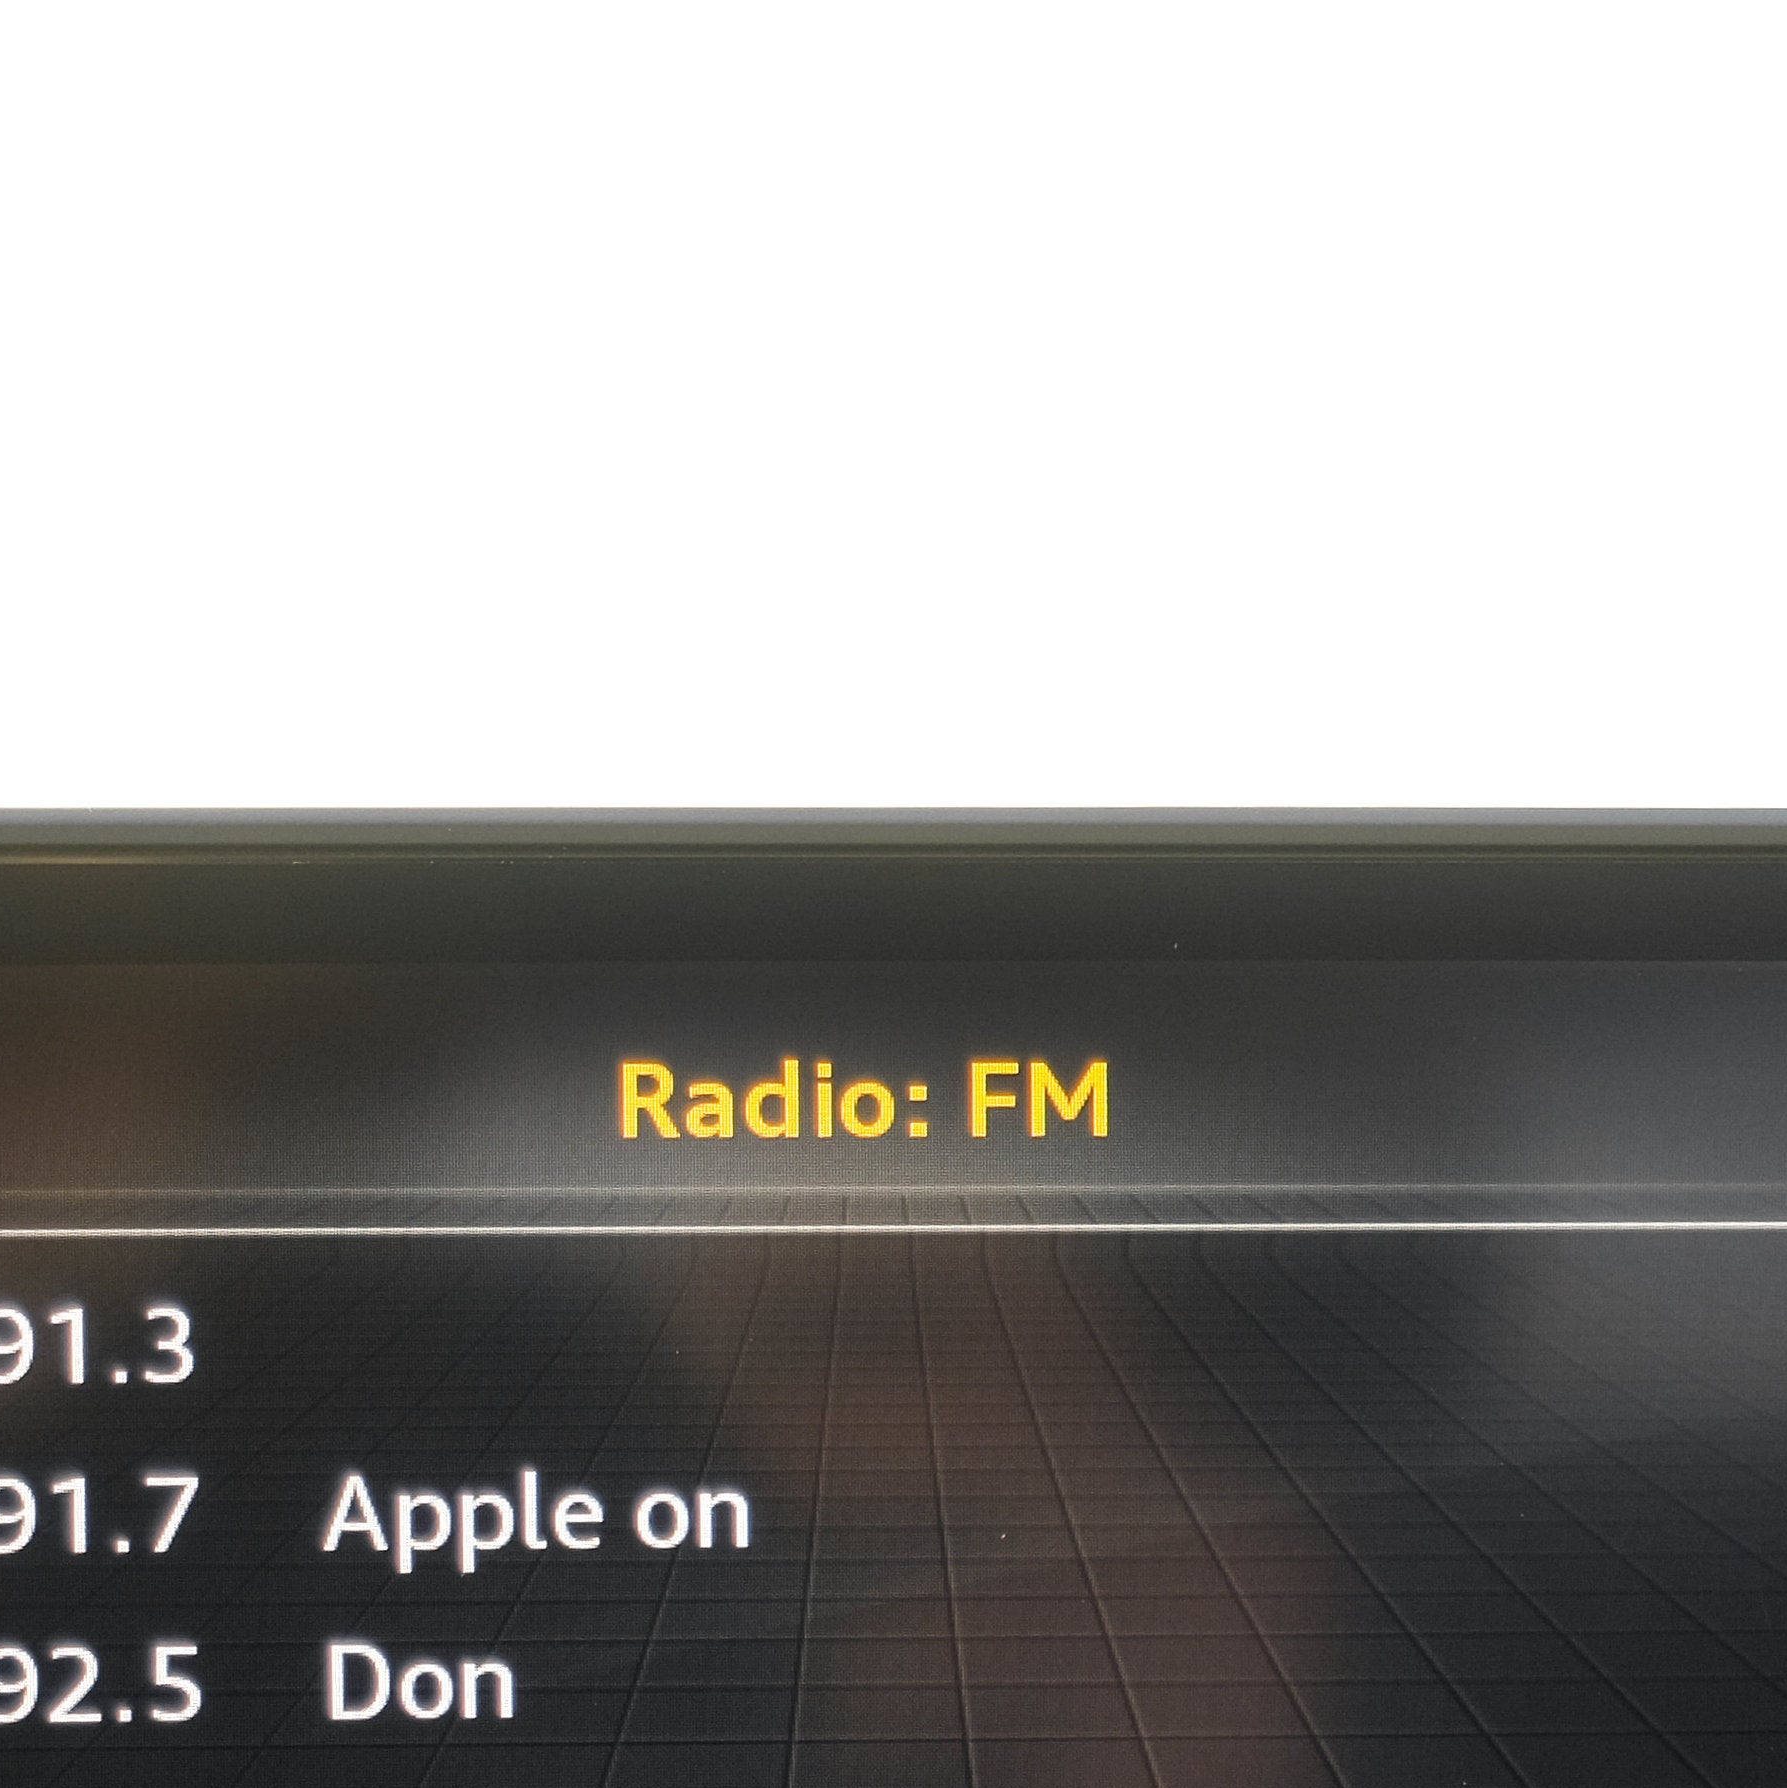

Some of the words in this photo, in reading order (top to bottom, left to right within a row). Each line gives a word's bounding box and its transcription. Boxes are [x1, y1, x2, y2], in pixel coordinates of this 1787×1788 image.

[619, 1056, 930, 1141] Radio:
[967, 1058, 1108, 1140] FM
[321, 1467, 605, 1575] Apple
[633, 1488, 750, 1549] on
[326, 1640, 514, 1721] Don
